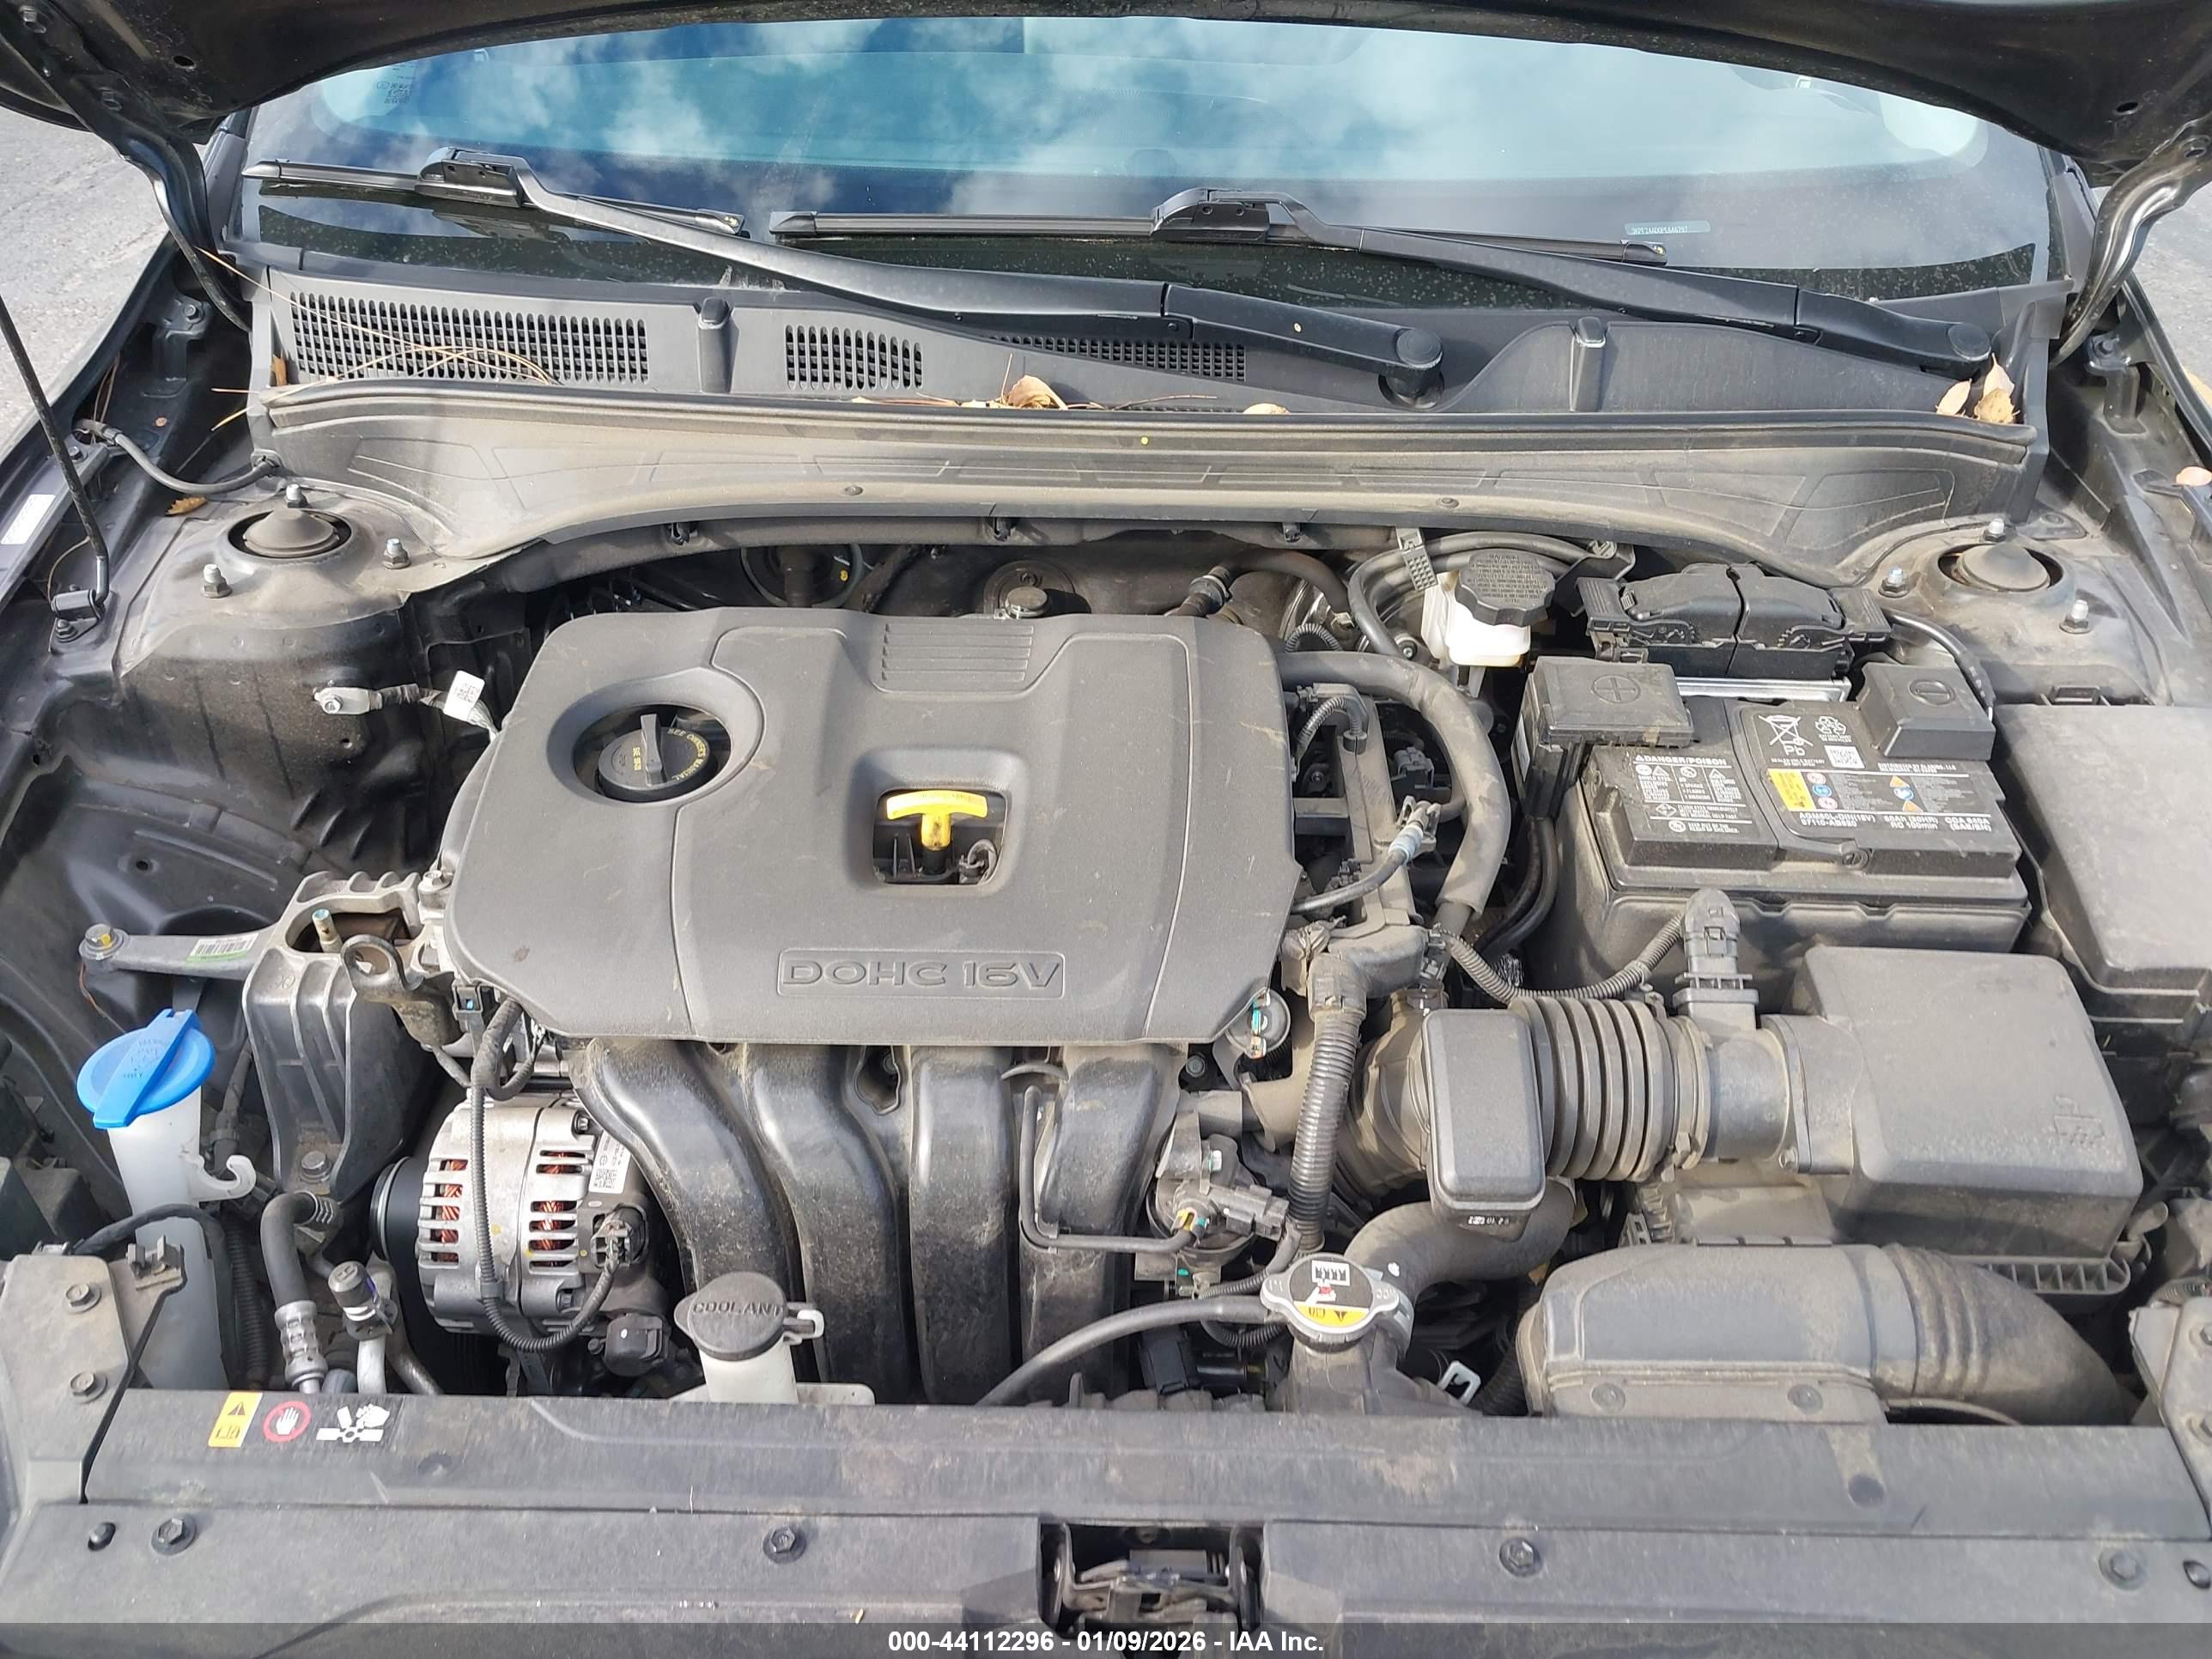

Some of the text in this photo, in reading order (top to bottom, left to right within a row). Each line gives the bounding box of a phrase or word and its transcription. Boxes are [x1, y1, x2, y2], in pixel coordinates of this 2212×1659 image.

[1784, 744, 1806, 757] Pb
[1644, 756, 1728, 765] DANGER/POISON
[782, 960, 1060, 988] DOHC 16V
[692, 1301, 783, 1317] COOLANT
